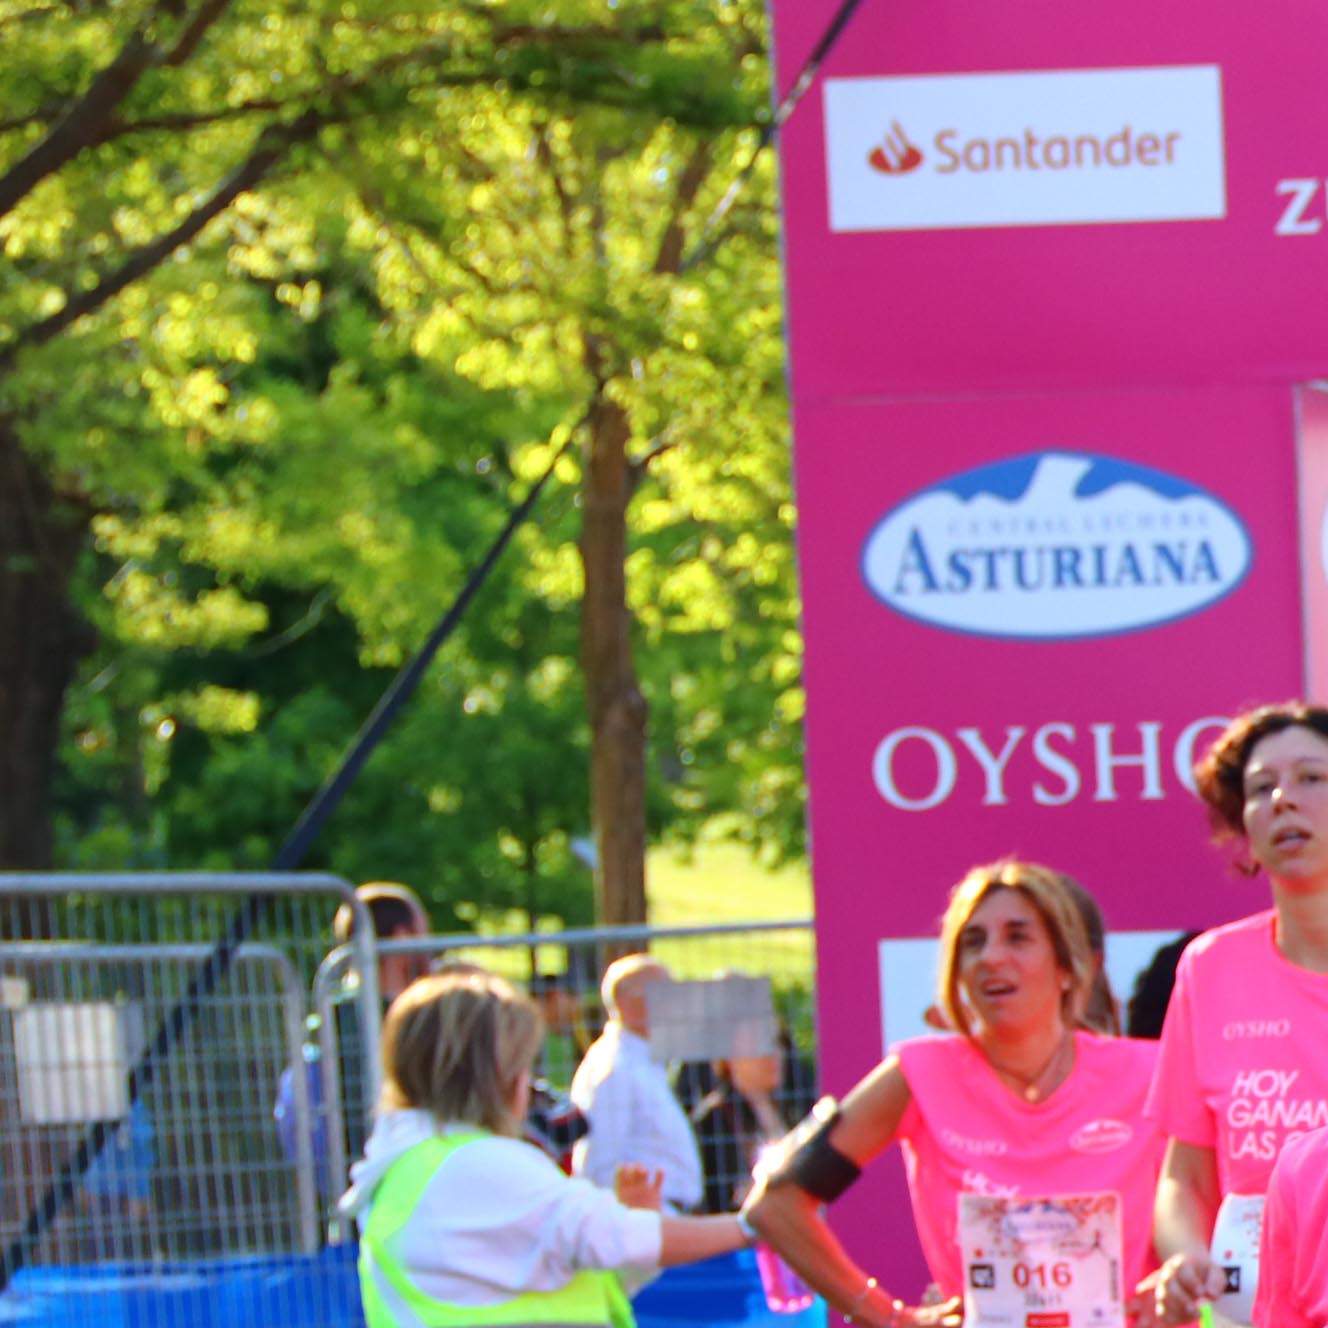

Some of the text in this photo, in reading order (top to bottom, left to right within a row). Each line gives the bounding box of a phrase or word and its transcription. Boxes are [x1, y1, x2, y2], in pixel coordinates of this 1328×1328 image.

[933, 126, 1181, 175] Santander
[893, 524, 1223, 596] ASTURIANA
[1222, 1019, 1290, 1041] OYSHO
[1231, 1069, 1298, 1098] HOY
[1227, 1131, 1277, 1161] LAS
[1011, 1262, 1074, 1289] 016
